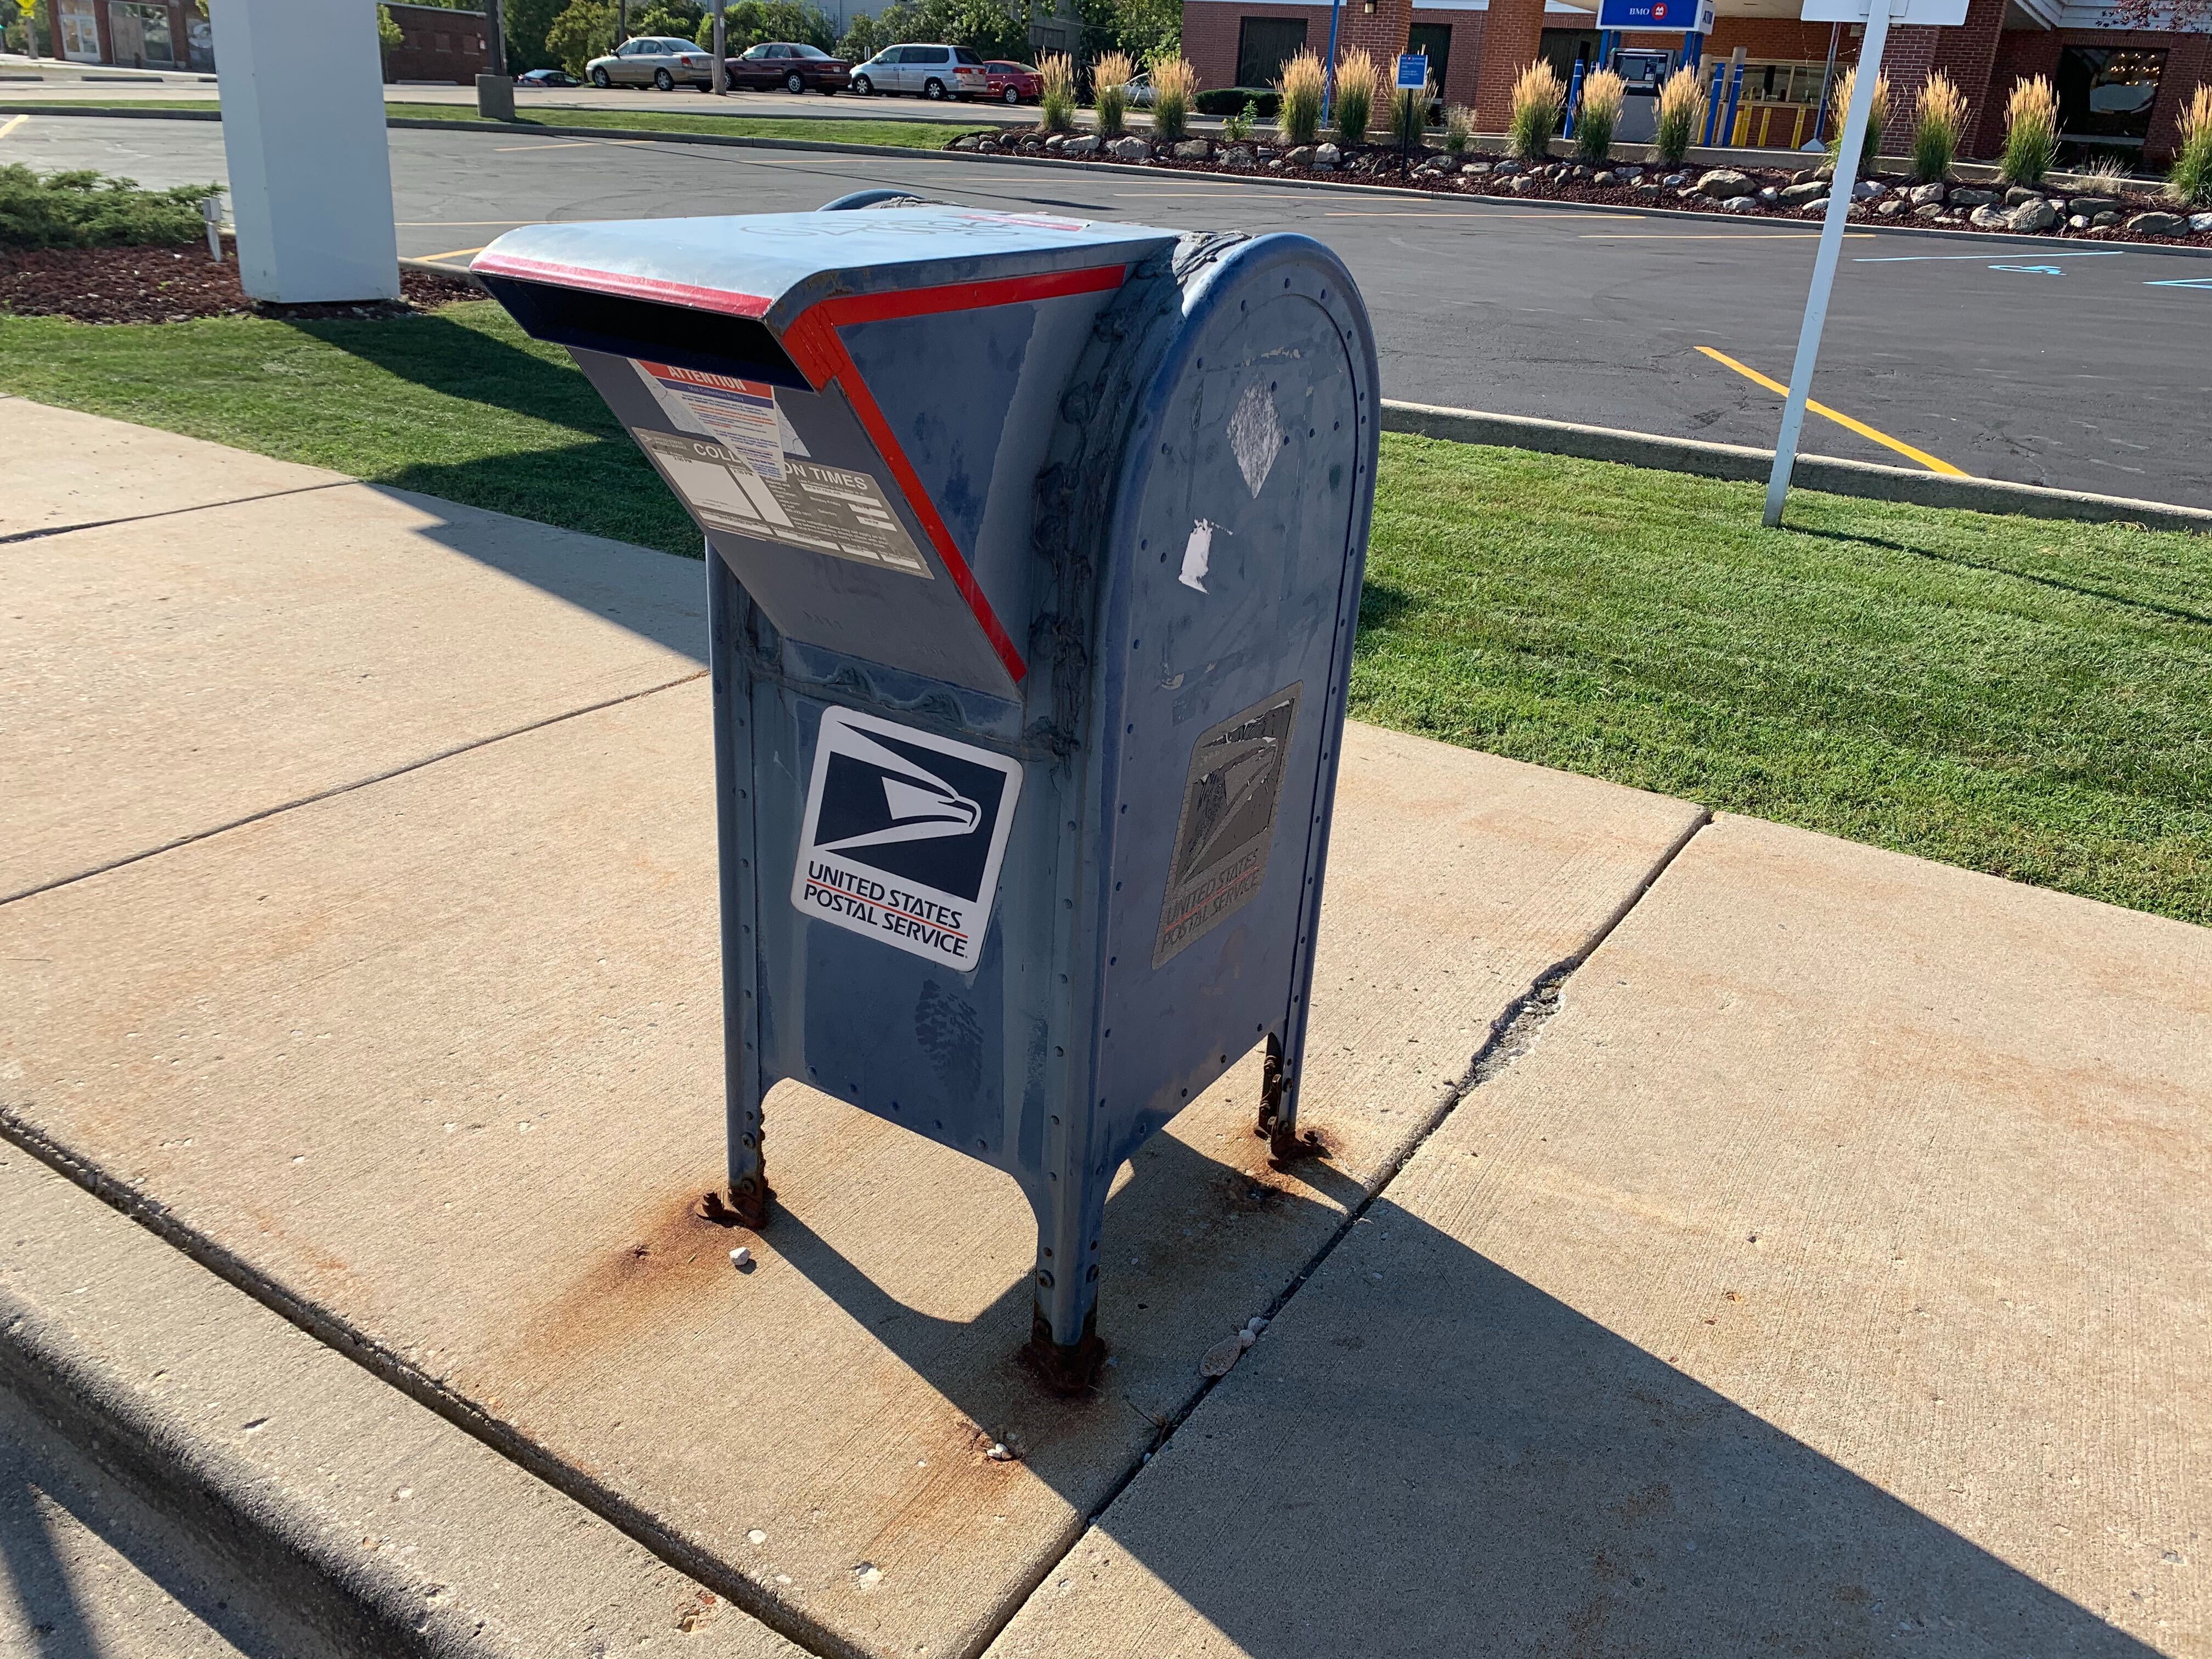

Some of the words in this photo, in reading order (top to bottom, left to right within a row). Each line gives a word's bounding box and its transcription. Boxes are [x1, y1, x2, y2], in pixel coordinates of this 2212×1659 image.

[667, 365, 747, 391] ATTENTION
[809, 467, 868, 490] TIMES
[804, 884, 878, 926] POSTAL
[809, 861, 885, 901] UNITED
[888, 889, 962, 929] STATES
[1161, 906, 1209, 952] POSTAL
[1210, 870, 1260, 917] SERVICE
[1167, 878, 1216, 925] UNITED
[1219, 848, 1259, 891] STATES
